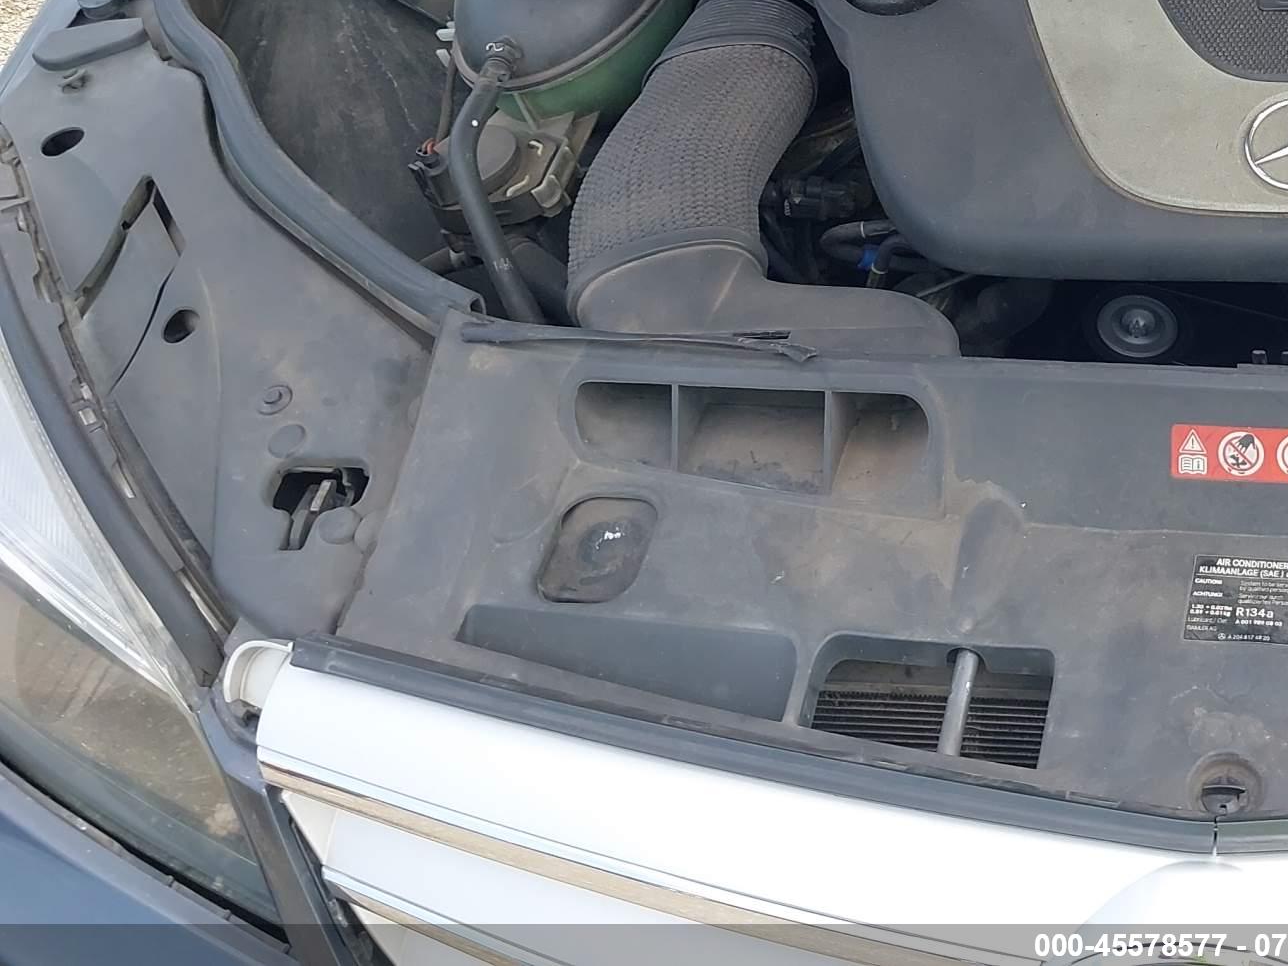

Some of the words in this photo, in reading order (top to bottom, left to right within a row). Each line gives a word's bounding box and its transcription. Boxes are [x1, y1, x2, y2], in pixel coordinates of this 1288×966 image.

[1216, 558, 1231, 567] AIR
[1199, 565, 1260, 577] KLIMAANLAGE
[1260, 569, 1279, 579] (SAE
